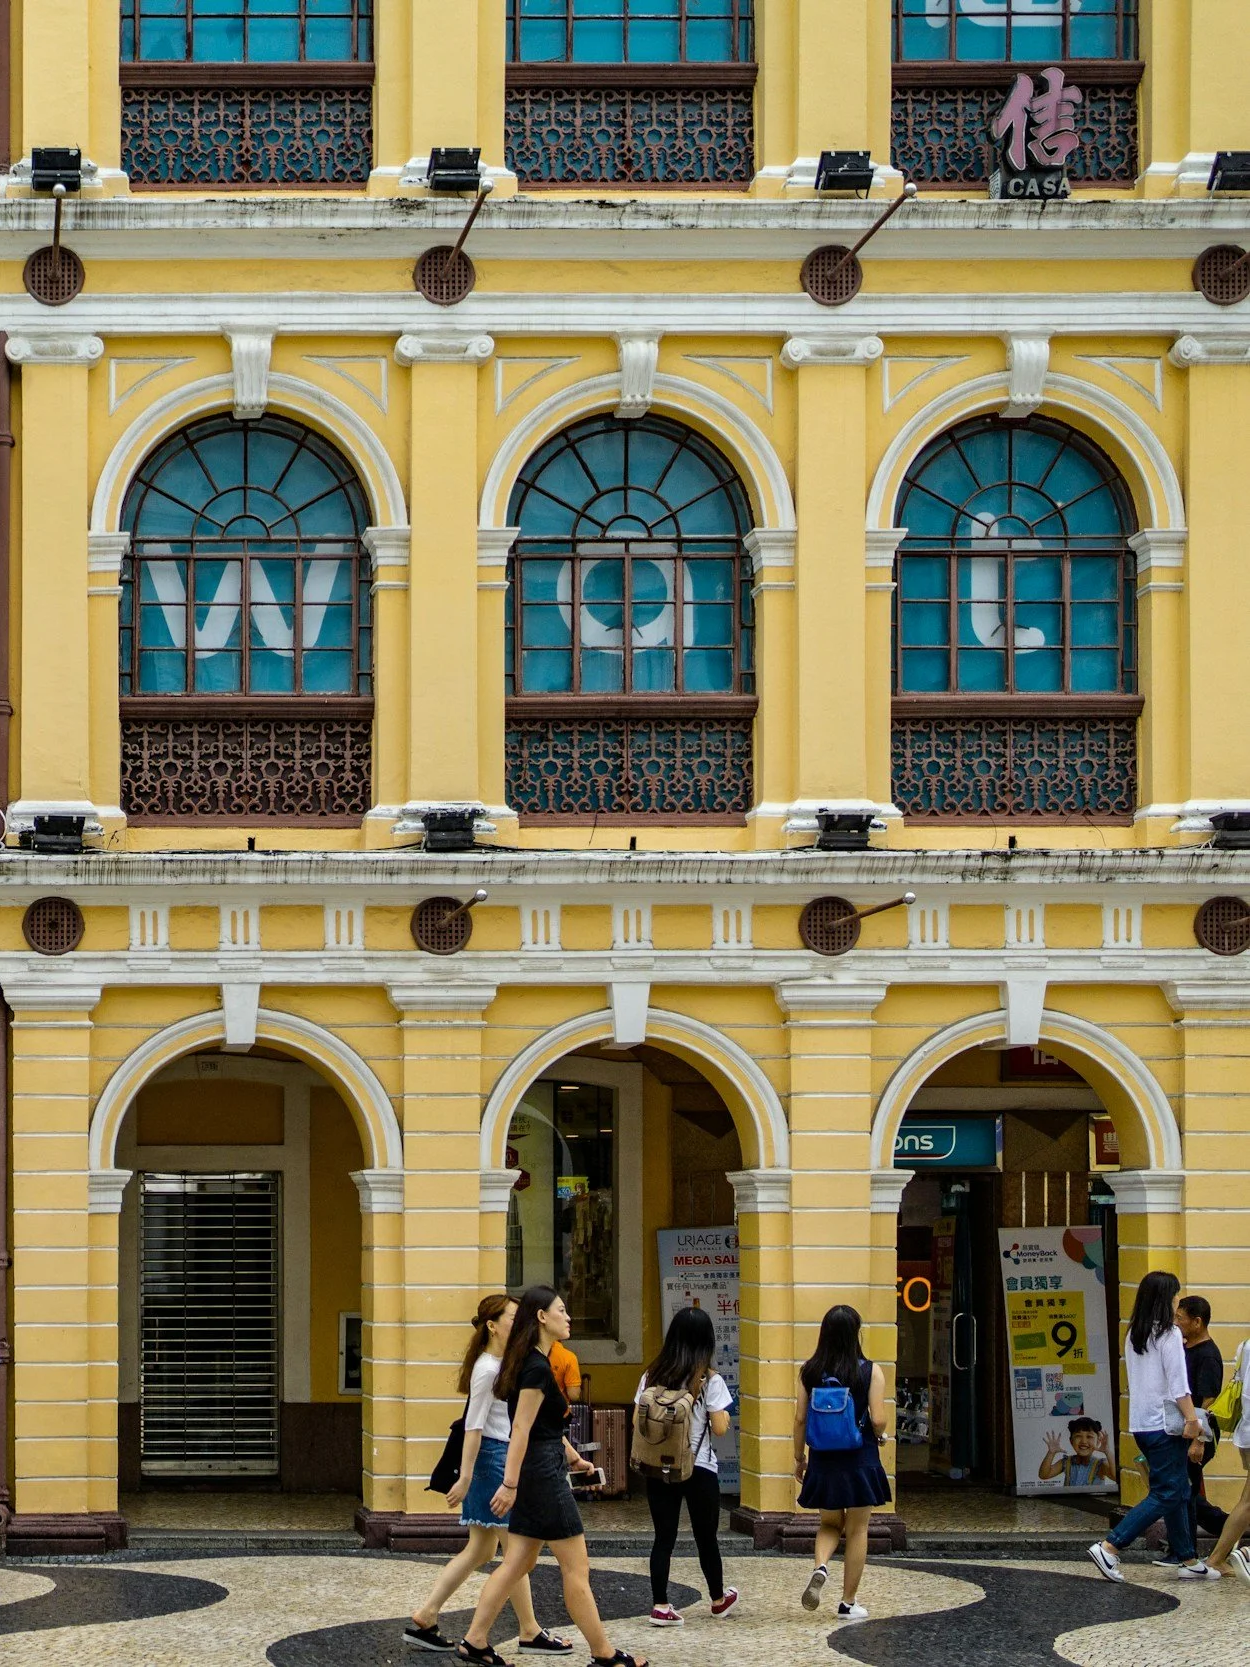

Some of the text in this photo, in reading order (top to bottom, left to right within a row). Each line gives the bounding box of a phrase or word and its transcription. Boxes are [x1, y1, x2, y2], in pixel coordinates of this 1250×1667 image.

[992, 67, 1082, 170] 信
[1008, 177, 1071, 197] CASA
[678, 1235, 722, 1247] URIAGE
[674, 1256, 711, 1265] MEGA
[1006, 1276, 1063, 1291] 會員獨享
